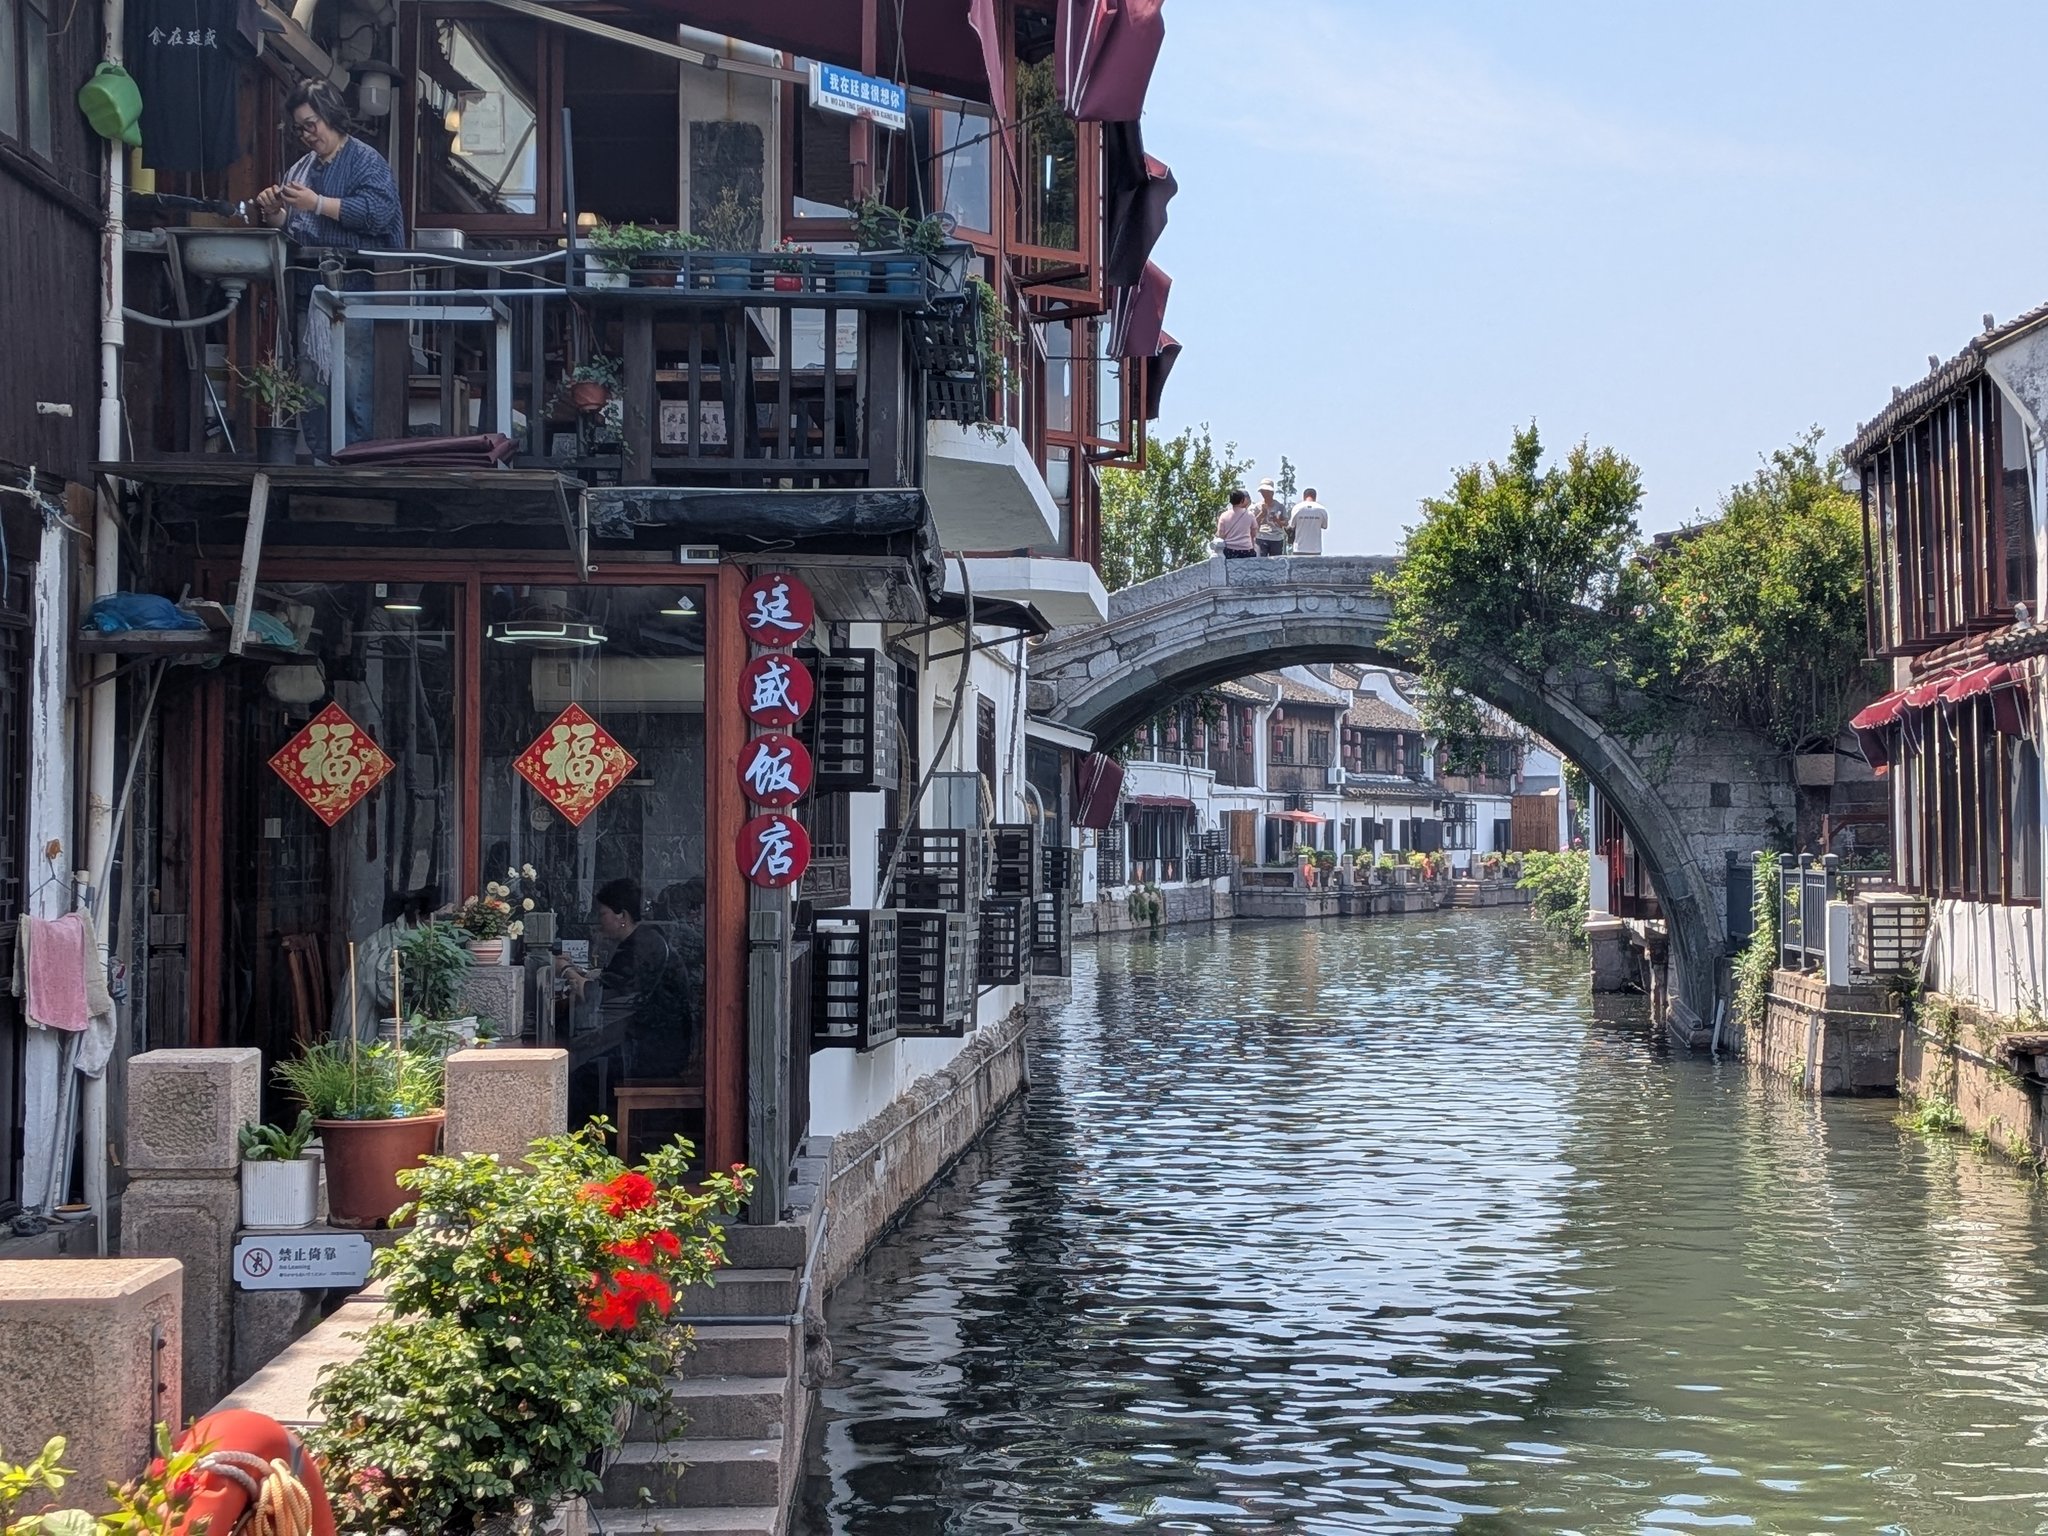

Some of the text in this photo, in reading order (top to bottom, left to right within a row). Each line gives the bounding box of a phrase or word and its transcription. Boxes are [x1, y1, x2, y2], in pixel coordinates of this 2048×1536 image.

[829, 73, 900, 108] 我在廷盛很想你
[299, 723, 361, 785] 福
[542, 722, 604, 786] 福
[745, 584, 804, 877] 廷盛饭店
[278, 1247, 337, 1262] 禁止倚靠
